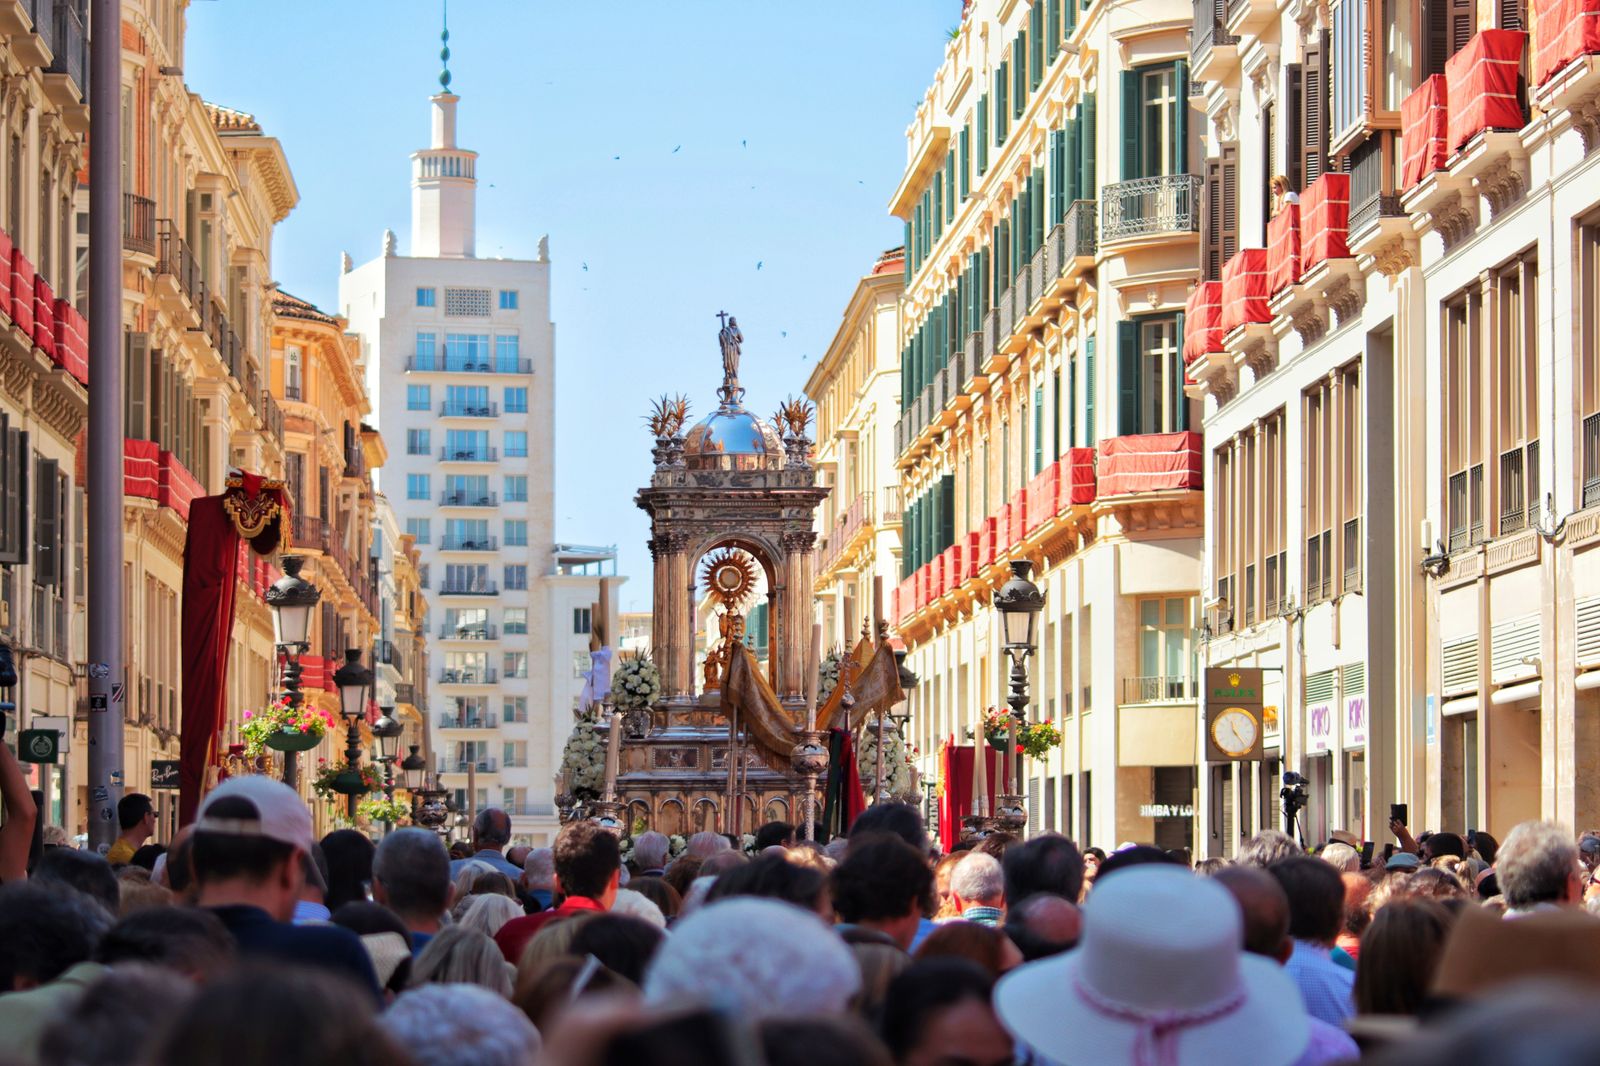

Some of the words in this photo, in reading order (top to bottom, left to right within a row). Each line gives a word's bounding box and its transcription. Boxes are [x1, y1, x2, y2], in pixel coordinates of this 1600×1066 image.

[1312, 706, 1331, 736] KIKO
[1139, 804, 1171, 817] BIMBA
[1171, 804, 1179, 817] Y
